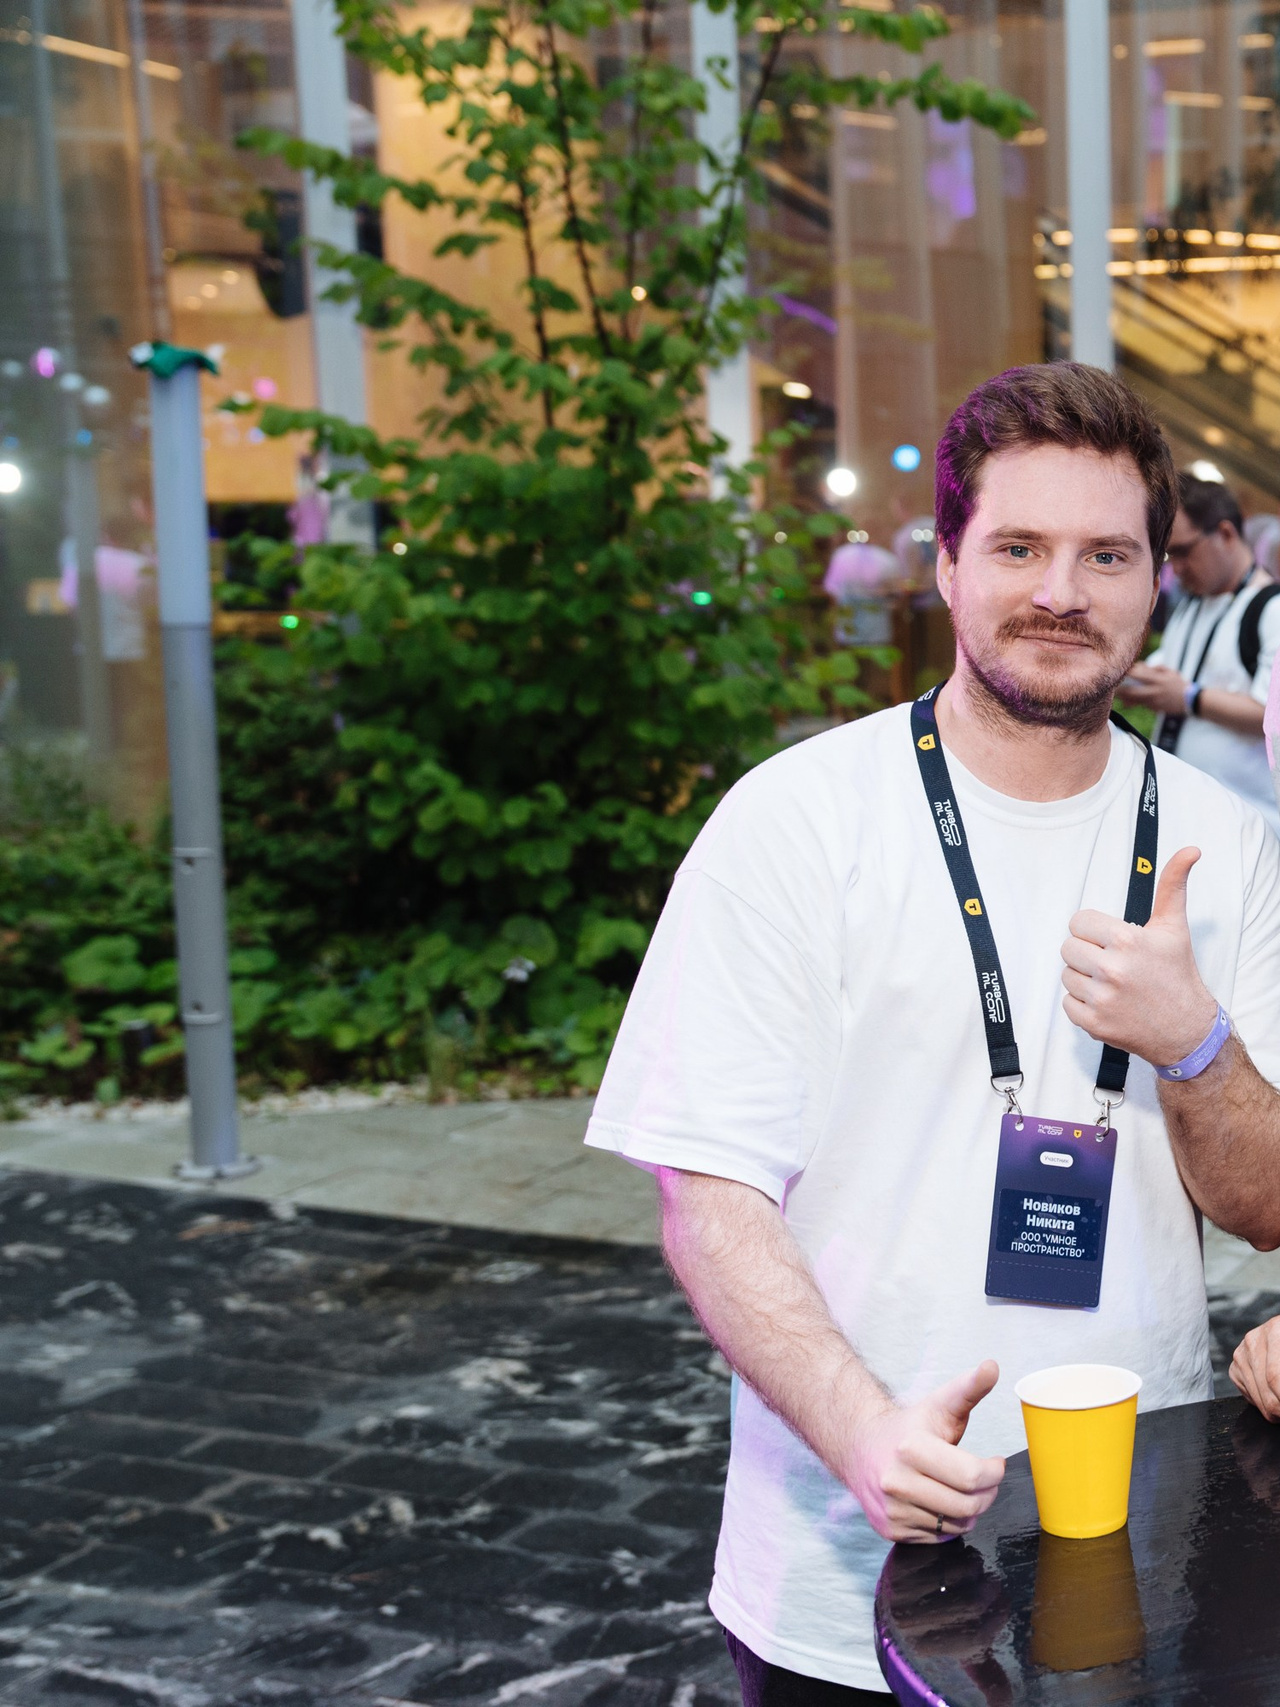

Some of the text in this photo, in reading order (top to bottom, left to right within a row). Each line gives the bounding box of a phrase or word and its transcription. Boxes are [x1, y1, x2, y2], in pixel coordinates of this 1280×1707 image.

[1023, 1198, 1081, 1216] Новиков
[1026, 1214, 1075, 1231] Никита
[1021, 1232, 1077, 1246] ООО "УМНОЕ
[1011, 1242, 1085, 1258] ПРОСТРАНСТВО"
